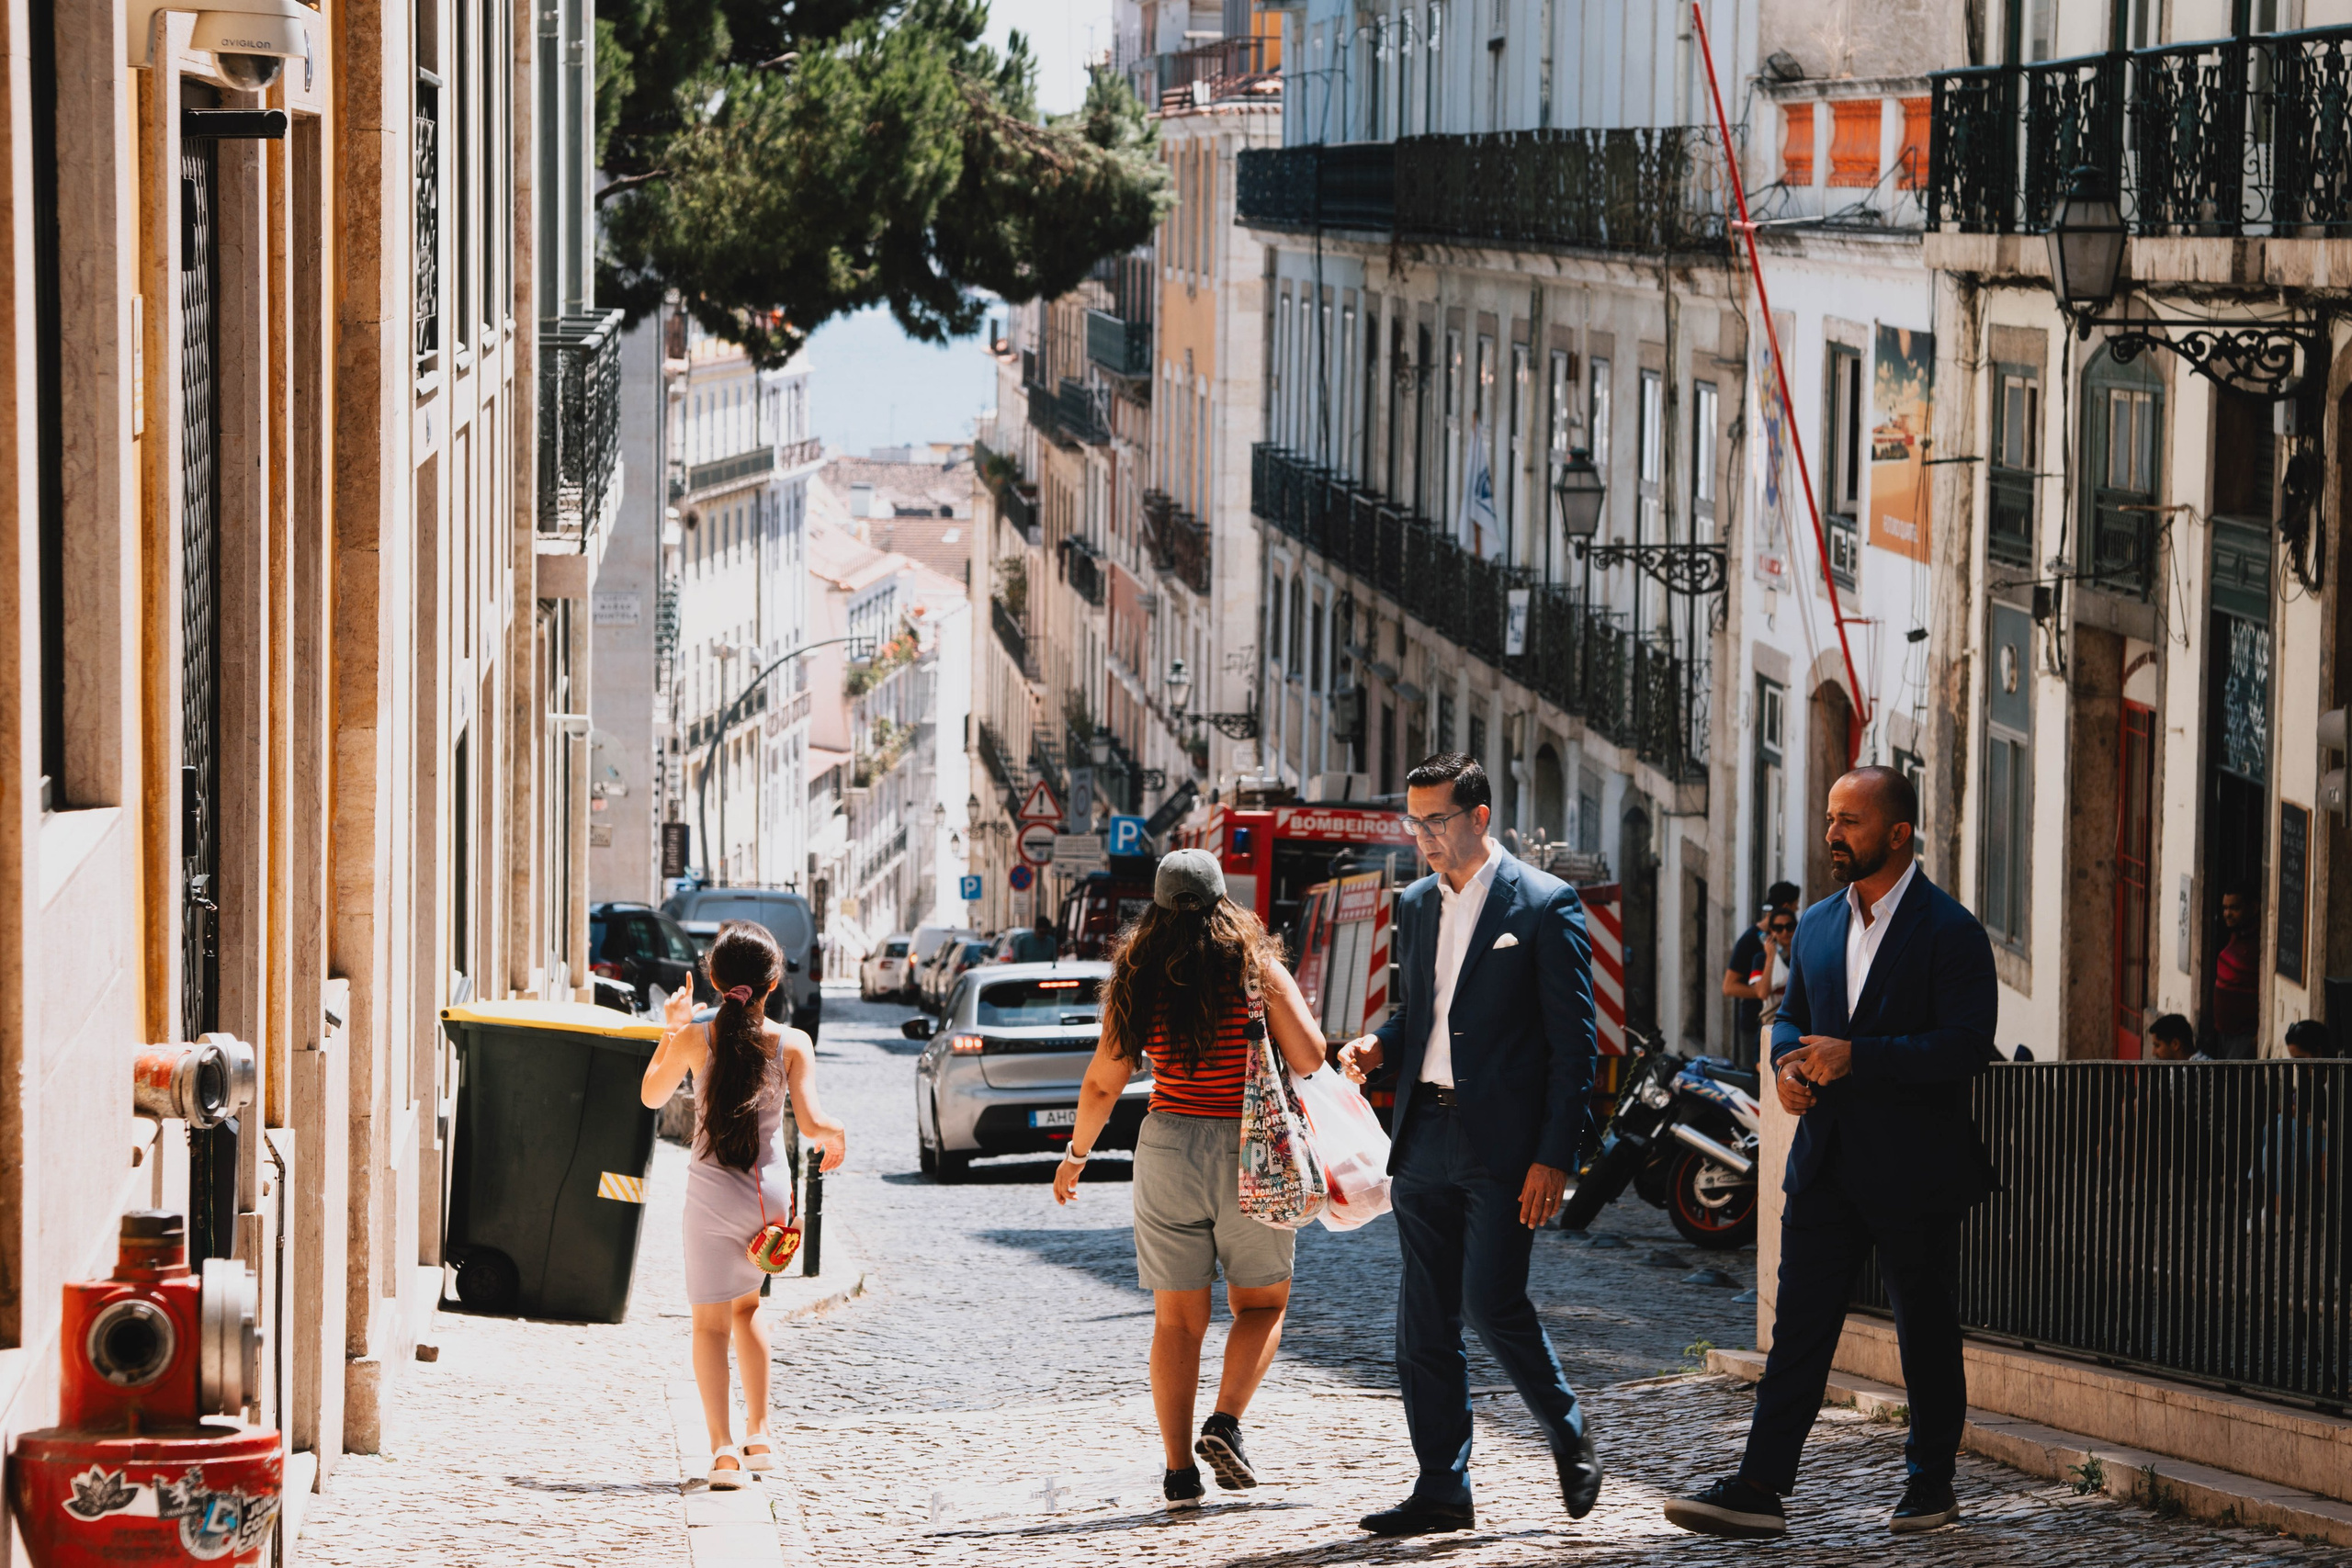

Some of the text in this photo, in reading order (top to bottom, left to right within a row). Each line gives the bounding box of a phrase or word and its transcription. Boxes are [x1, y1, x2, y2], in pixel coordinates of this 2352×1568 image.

[1117, 820, 1139, 850] P
[1290, 816, 1401, 835] BOMBEIROS
[965, 877, 978, 898] P
